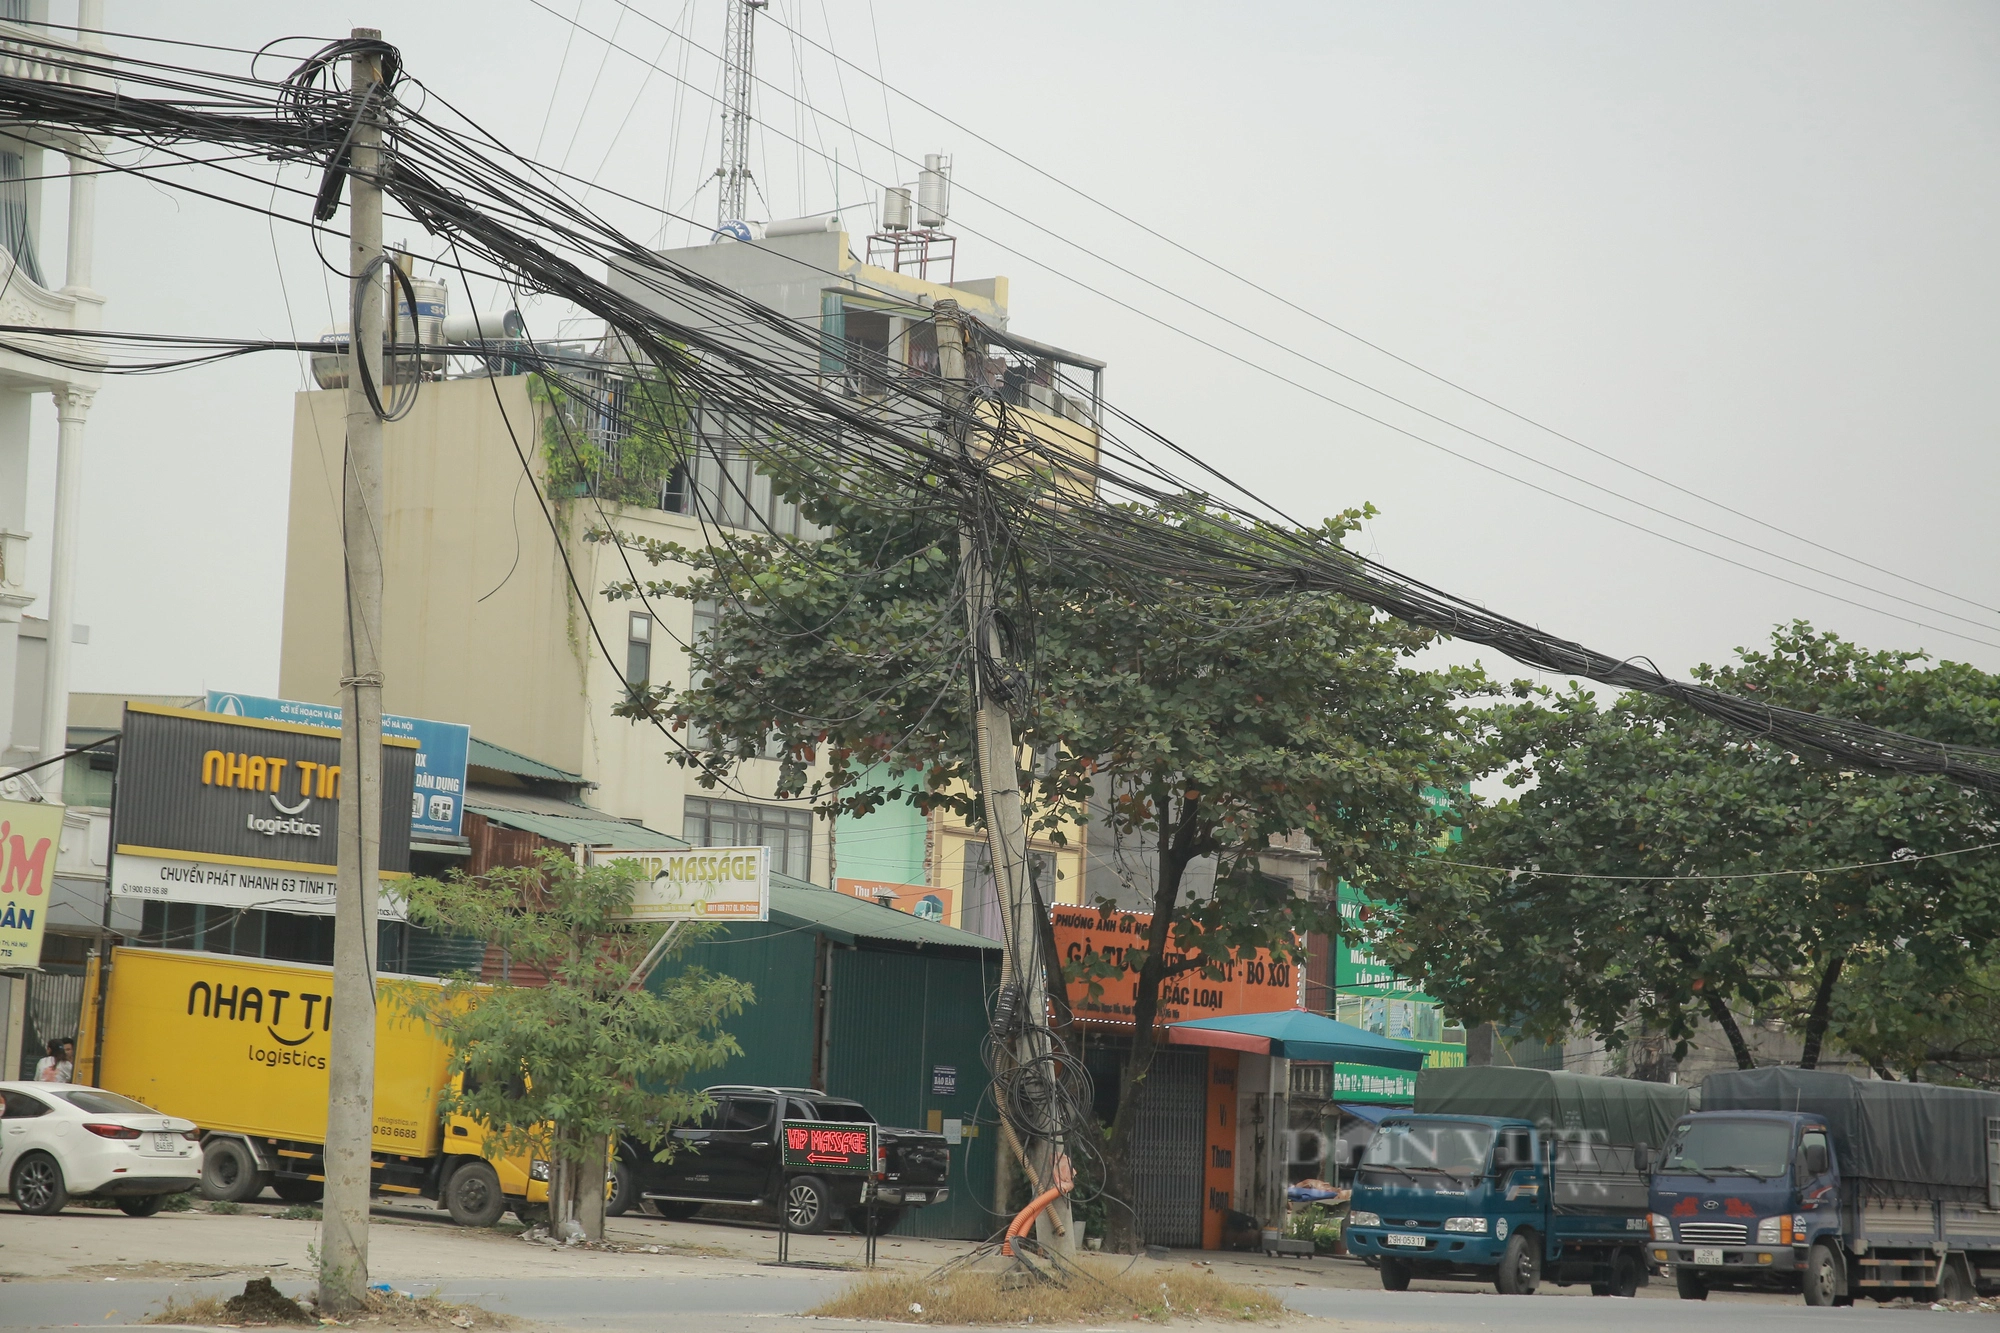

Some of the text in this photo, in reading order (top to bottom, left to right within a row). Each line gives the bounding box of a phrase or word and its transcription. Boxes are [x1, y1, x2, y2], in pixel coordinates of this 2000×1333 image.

[300, 708, 323, 718] HOẠCH
[401, 722, 413, 732] NỘI
[202, 749, 287, 793] NHAT
[416, 771, 459, 793] DÂN DỤNG
[247, 814, 321, 837] logistics
[160, 863, 204, 884] CHUYỂN
[206, 869, 236, 886] PHÁT
[239, 874, 279, 891] NHANH
[281, 878, 295, 892] 63
[299, 877, 324, 894] TỈNH
[668, 856, 756, 884] MASSAGE
[128, 885, 143, 893] 1900
[854, 884, 870, 897] Thu
[1246, 955, 1265, 985] BÓ
[187, 981, 290, 1025] NHAT
[1193, 988, 1223, 1011] LOẠI
[249, 1045, 326, 1070] logistics
[380, 1126, 392, 1136] 63
[393, 1127, 417, 1139] 6688
[787, 1128, 867, 1155] VIP MASSAGE
